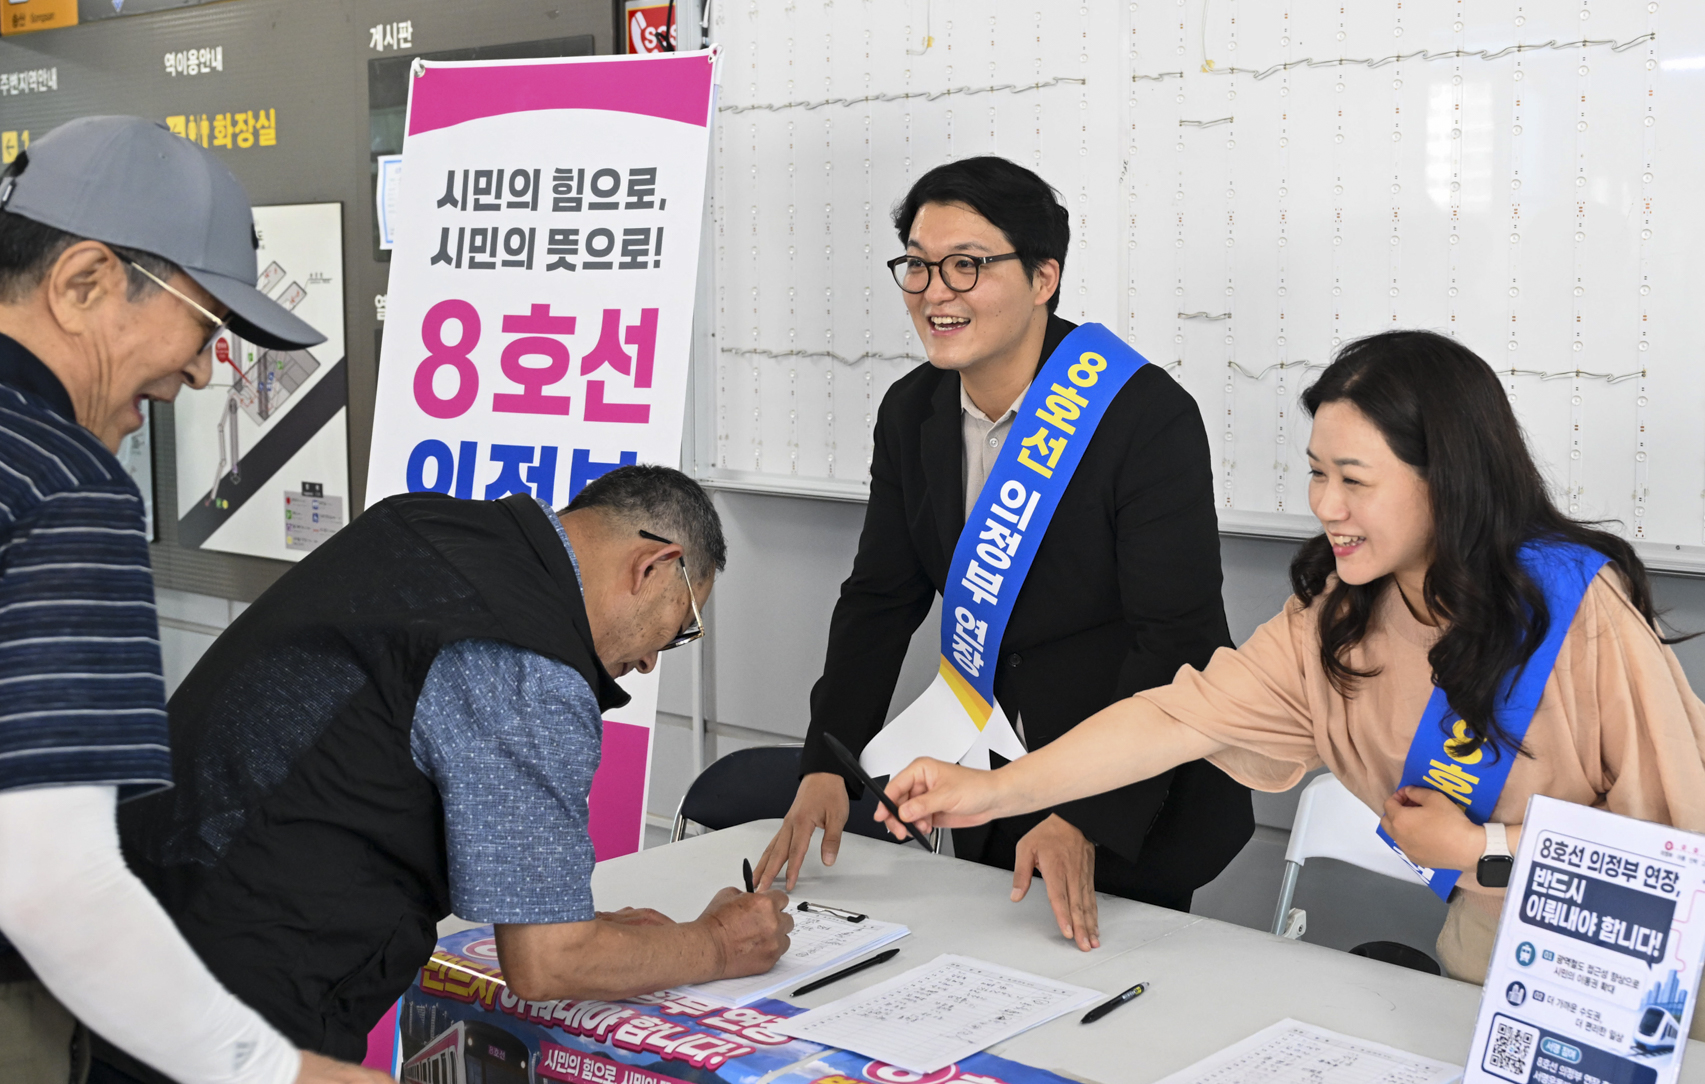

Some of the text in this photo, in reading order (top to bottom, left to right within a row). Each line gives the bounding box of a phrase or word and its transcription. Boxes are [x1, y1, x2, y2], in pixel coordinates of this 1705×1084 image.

[369, 20, 413, 52] 게시판
[0, 67, 58, 96] 주변지역안내
[164, 46, 223, 77] 역이용안내
[213, 108, 277, 149] 화장실
[436, 167, 541, 213] 시민의
[551, 165, 667, 213] 힘으로,
[430, 225, 665, 273] 시민의 뜻으로!
[413, 298, 660, 425] 8호선
[1017, 351, 1108, 480] 8호선
[961, 480, 1042, 606] 의정부
[952, 606, 989, 679] 연장
[1531, 865, 1587, 904] 반드시
[1538, 836, 1585, 869] 8호선
[1589, 850, 1640, 884] 의정부
[1643, 863, 1682, 899] 연장,
[1525, 893, 1665, 959] 이뤄내야 합니다!
[1547, 995, 1555, 1006] 더
[1575, 1018, 1583, 1029] 더
[544, 1049, 582, 1077] 시민의
[615, 1015, 753, 1065] 합니다!
